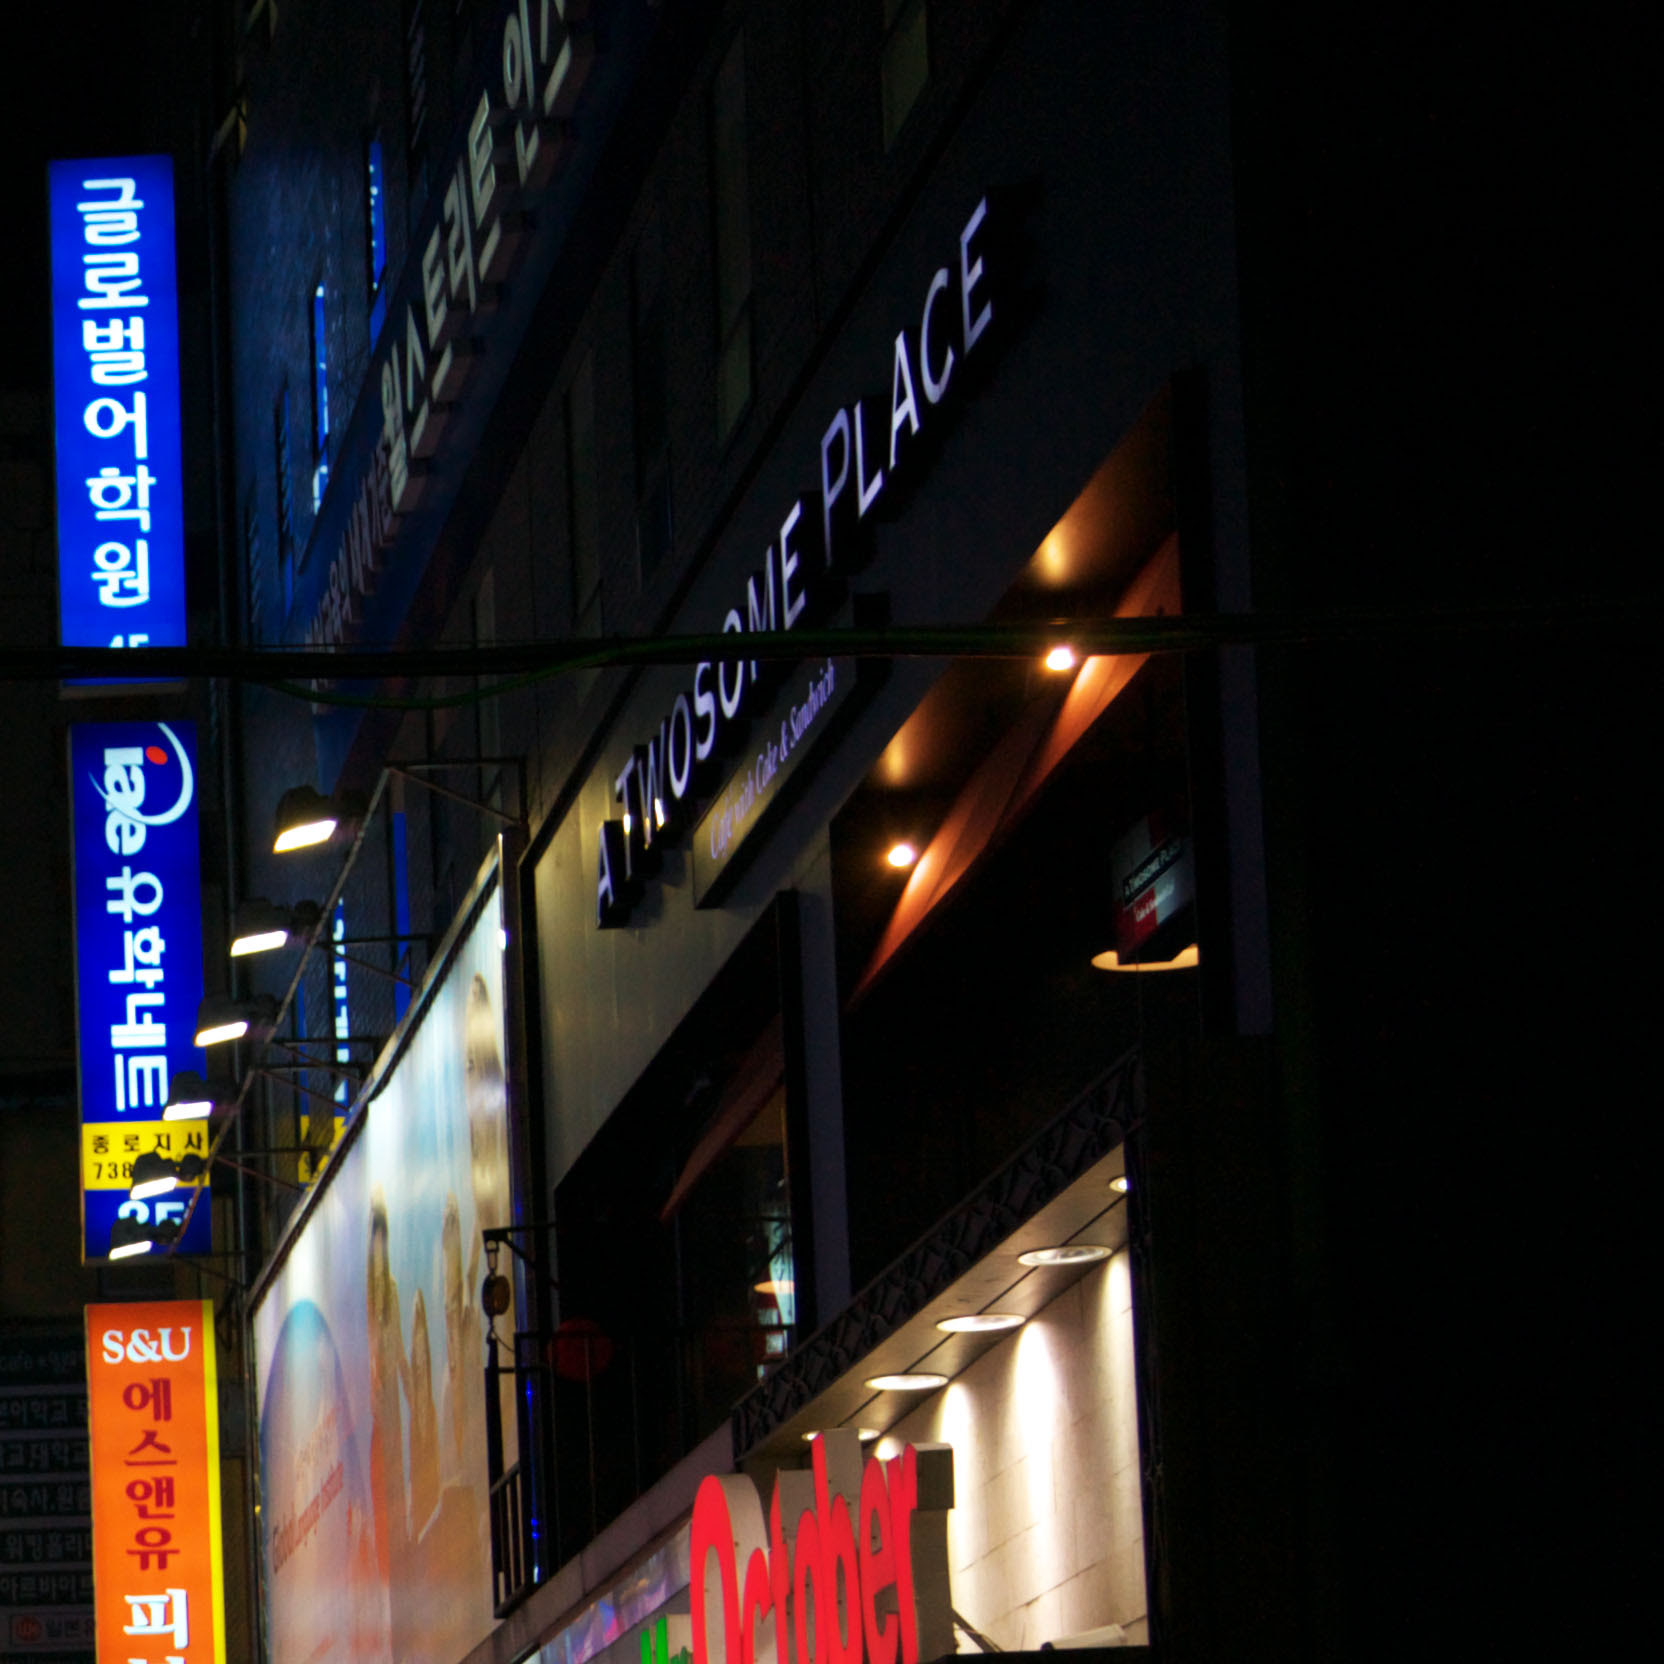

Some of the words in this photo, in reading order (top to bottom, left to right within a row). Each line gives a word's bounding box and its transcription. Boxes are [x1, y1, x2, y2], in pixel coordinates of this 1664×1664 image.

[76, 176, 157, 609] 글로벌어학원
[819, 196, 993, 570] PLACE
[105, 866, 169, 1114] 유학네트
[102, 1327, 191, 1364] S&U
[122, 1376, 181, 1573] 에스앤유
